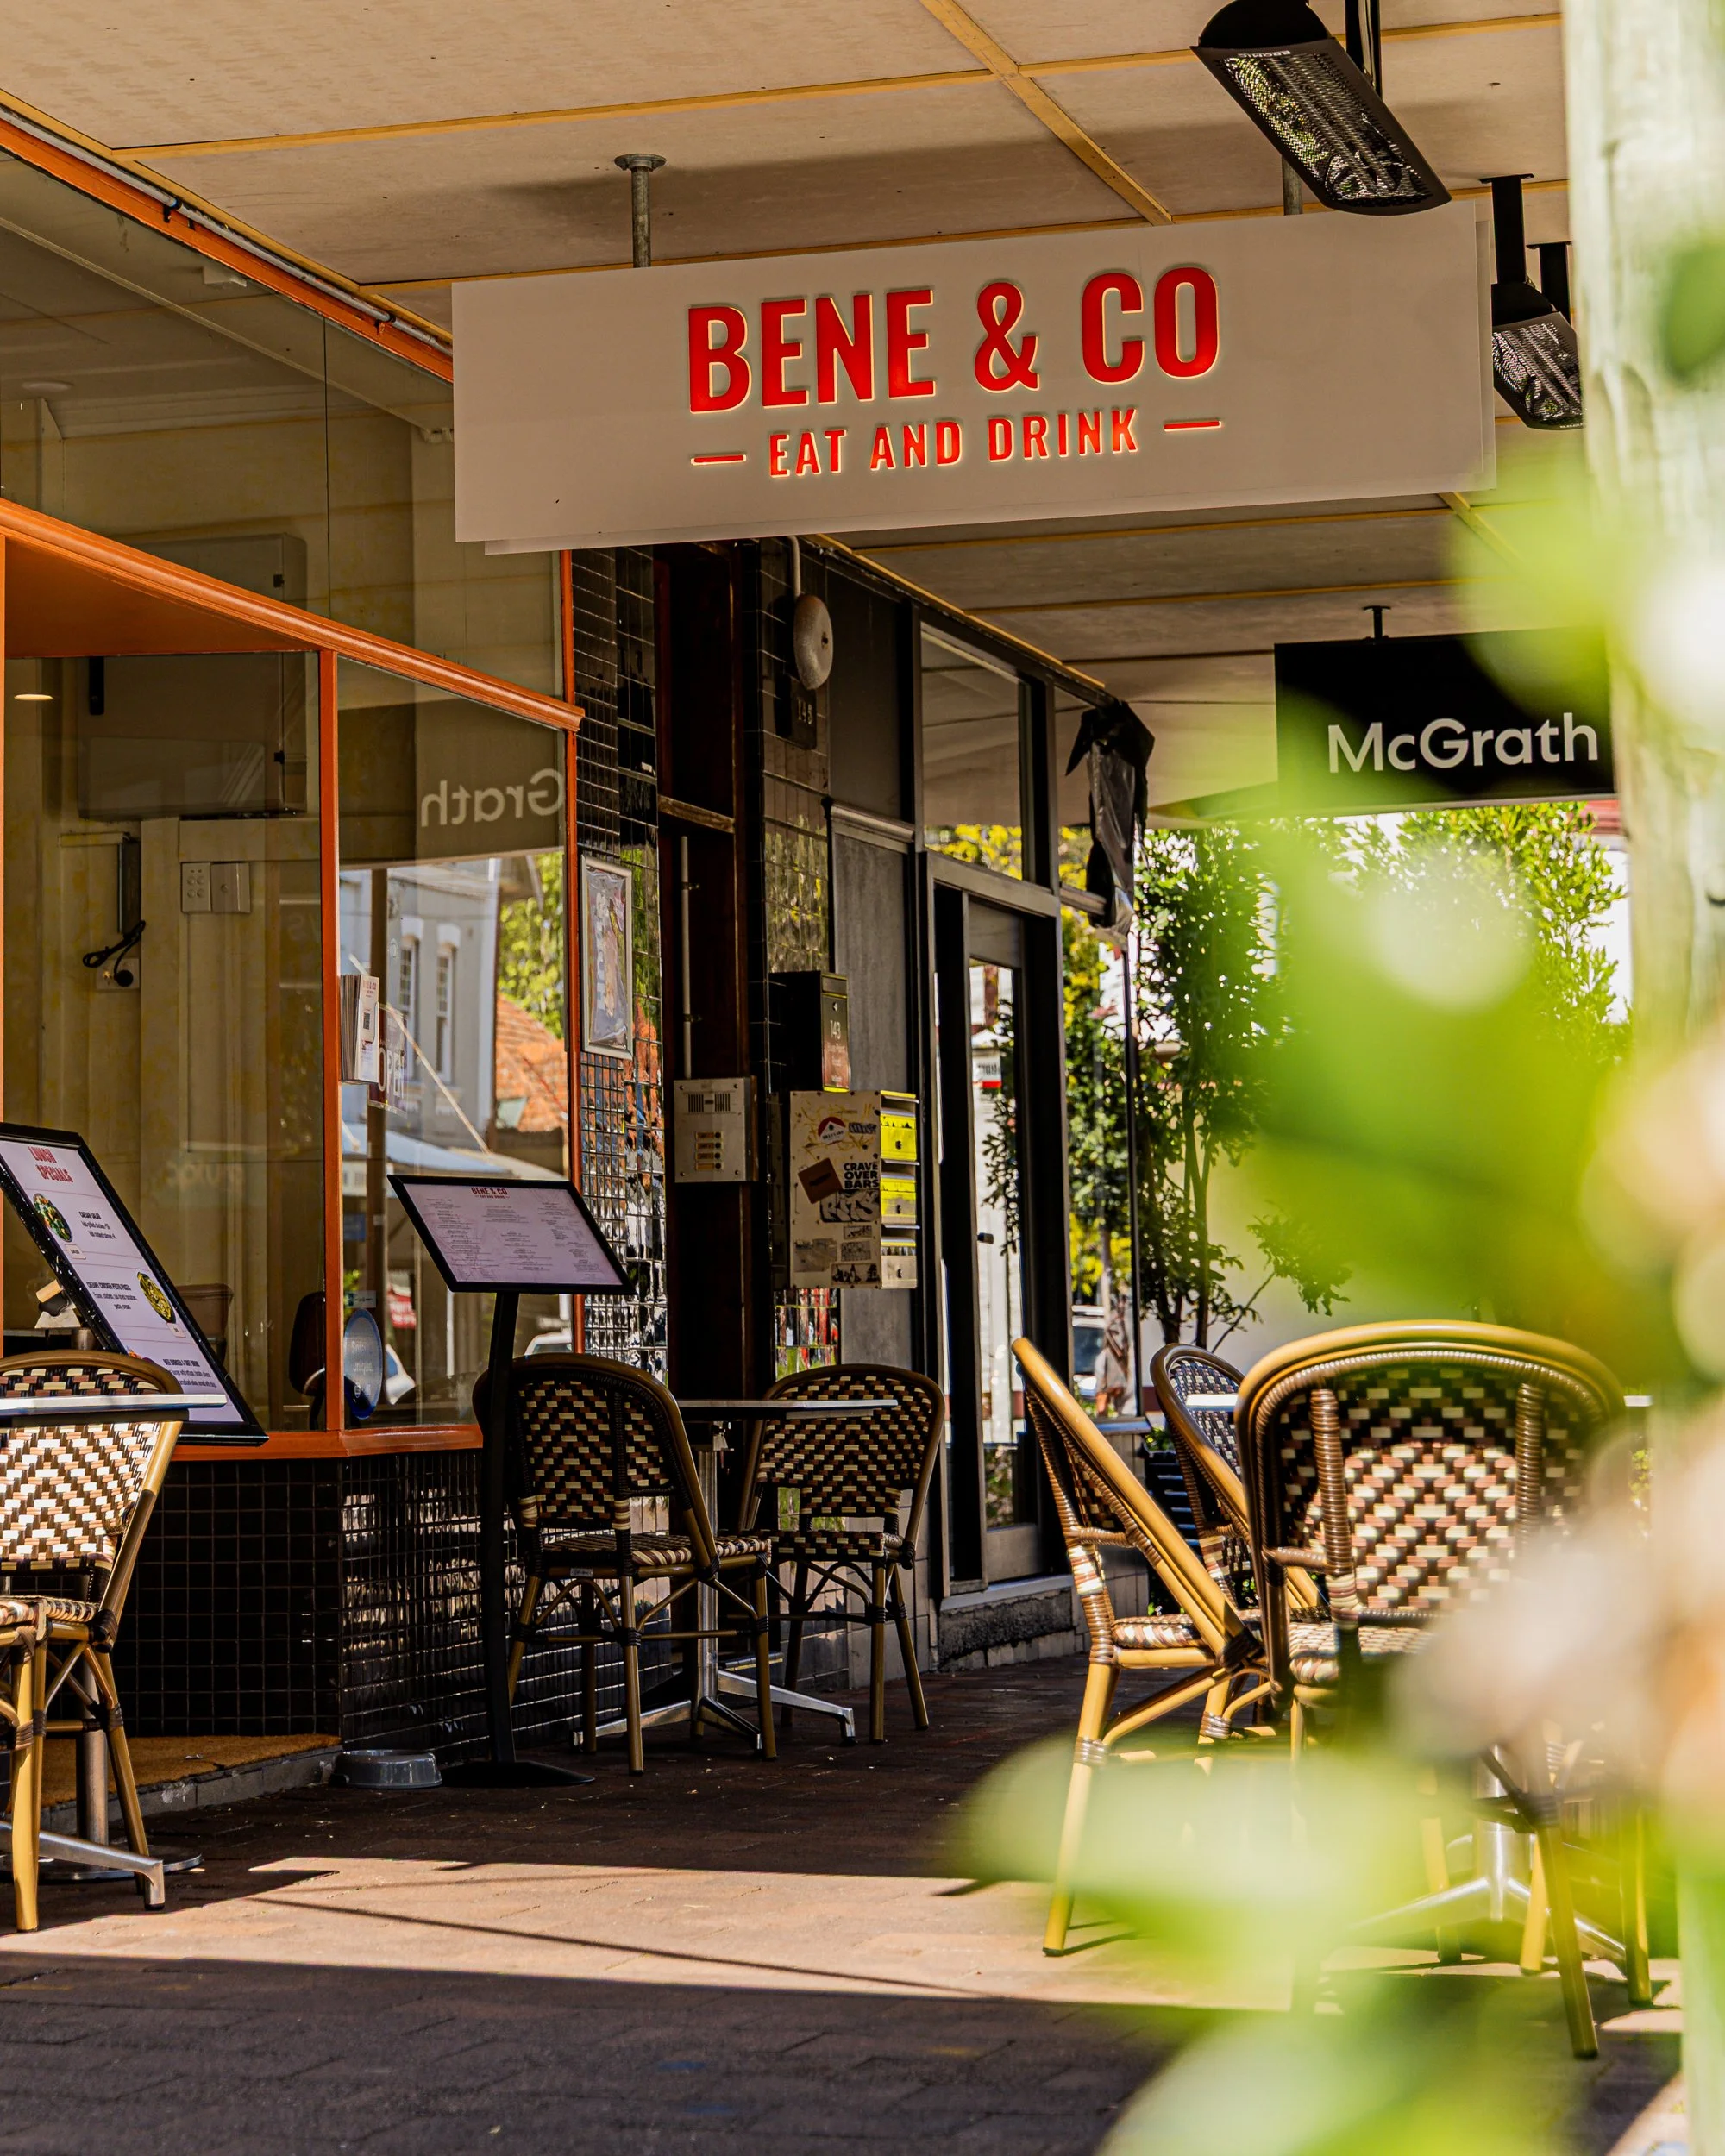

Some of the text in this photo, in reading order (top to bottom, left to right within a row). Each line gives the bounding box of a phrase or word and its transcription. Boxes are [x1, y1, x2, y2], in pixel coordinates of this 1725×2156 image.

[688, 266, 1222, 414] BENE & CO
[769, 407, 1138, 478] EAT AND DRINK
[1327, 712, 1598, 774] McGrath
[28, 1146, 57, 1163] LUNCH
[35, 1164, 74, 1183] SPECIALS
[844, 1163, 878, 1171] CRAVE
[844, 1170, 878, 1180] OVER
[844, 1180, 880, 1188] BARS
